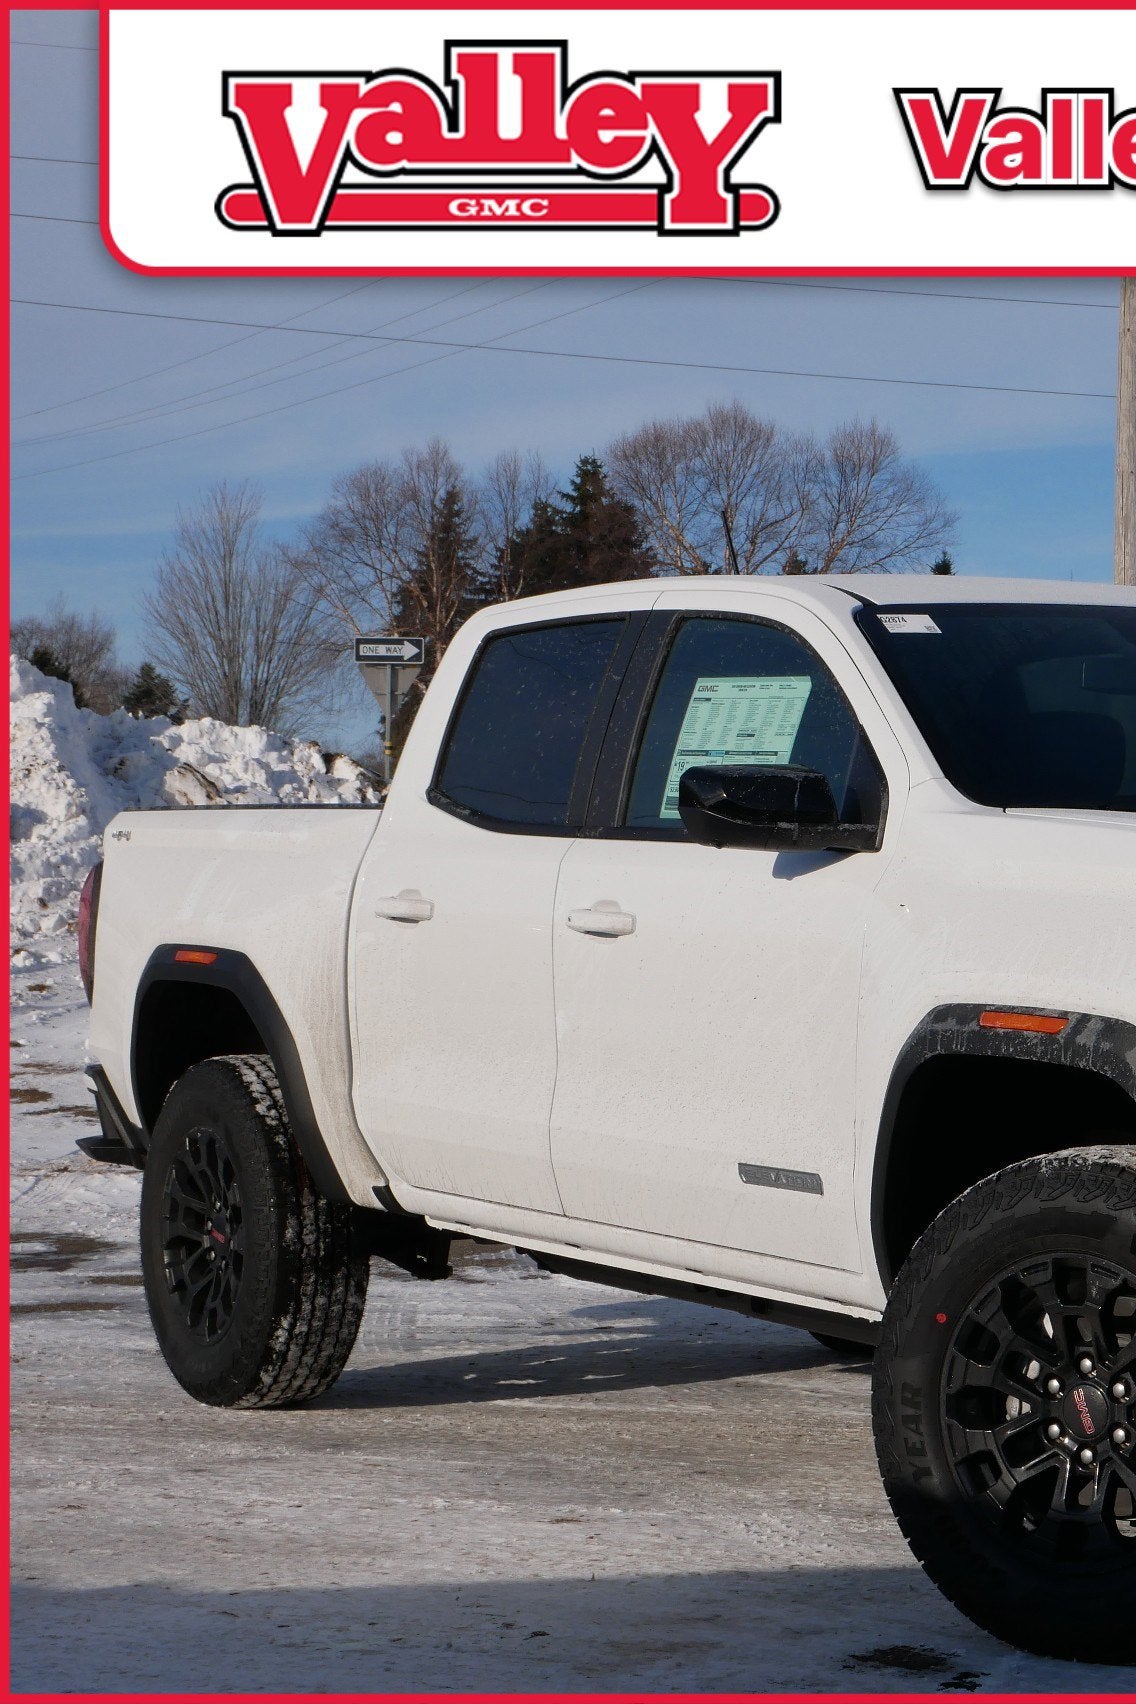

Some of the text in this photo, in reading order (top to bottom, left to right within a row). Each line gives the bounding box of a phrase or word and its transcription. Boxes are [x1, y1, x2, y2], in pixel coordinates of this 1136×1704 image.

[362, 645, 404, 654] ONE WAY
[698, 685, 719, 693] GMC
[1073, 1388, 1096, 1436] GMC
[899, 1380, 934, 1482] YEAR
